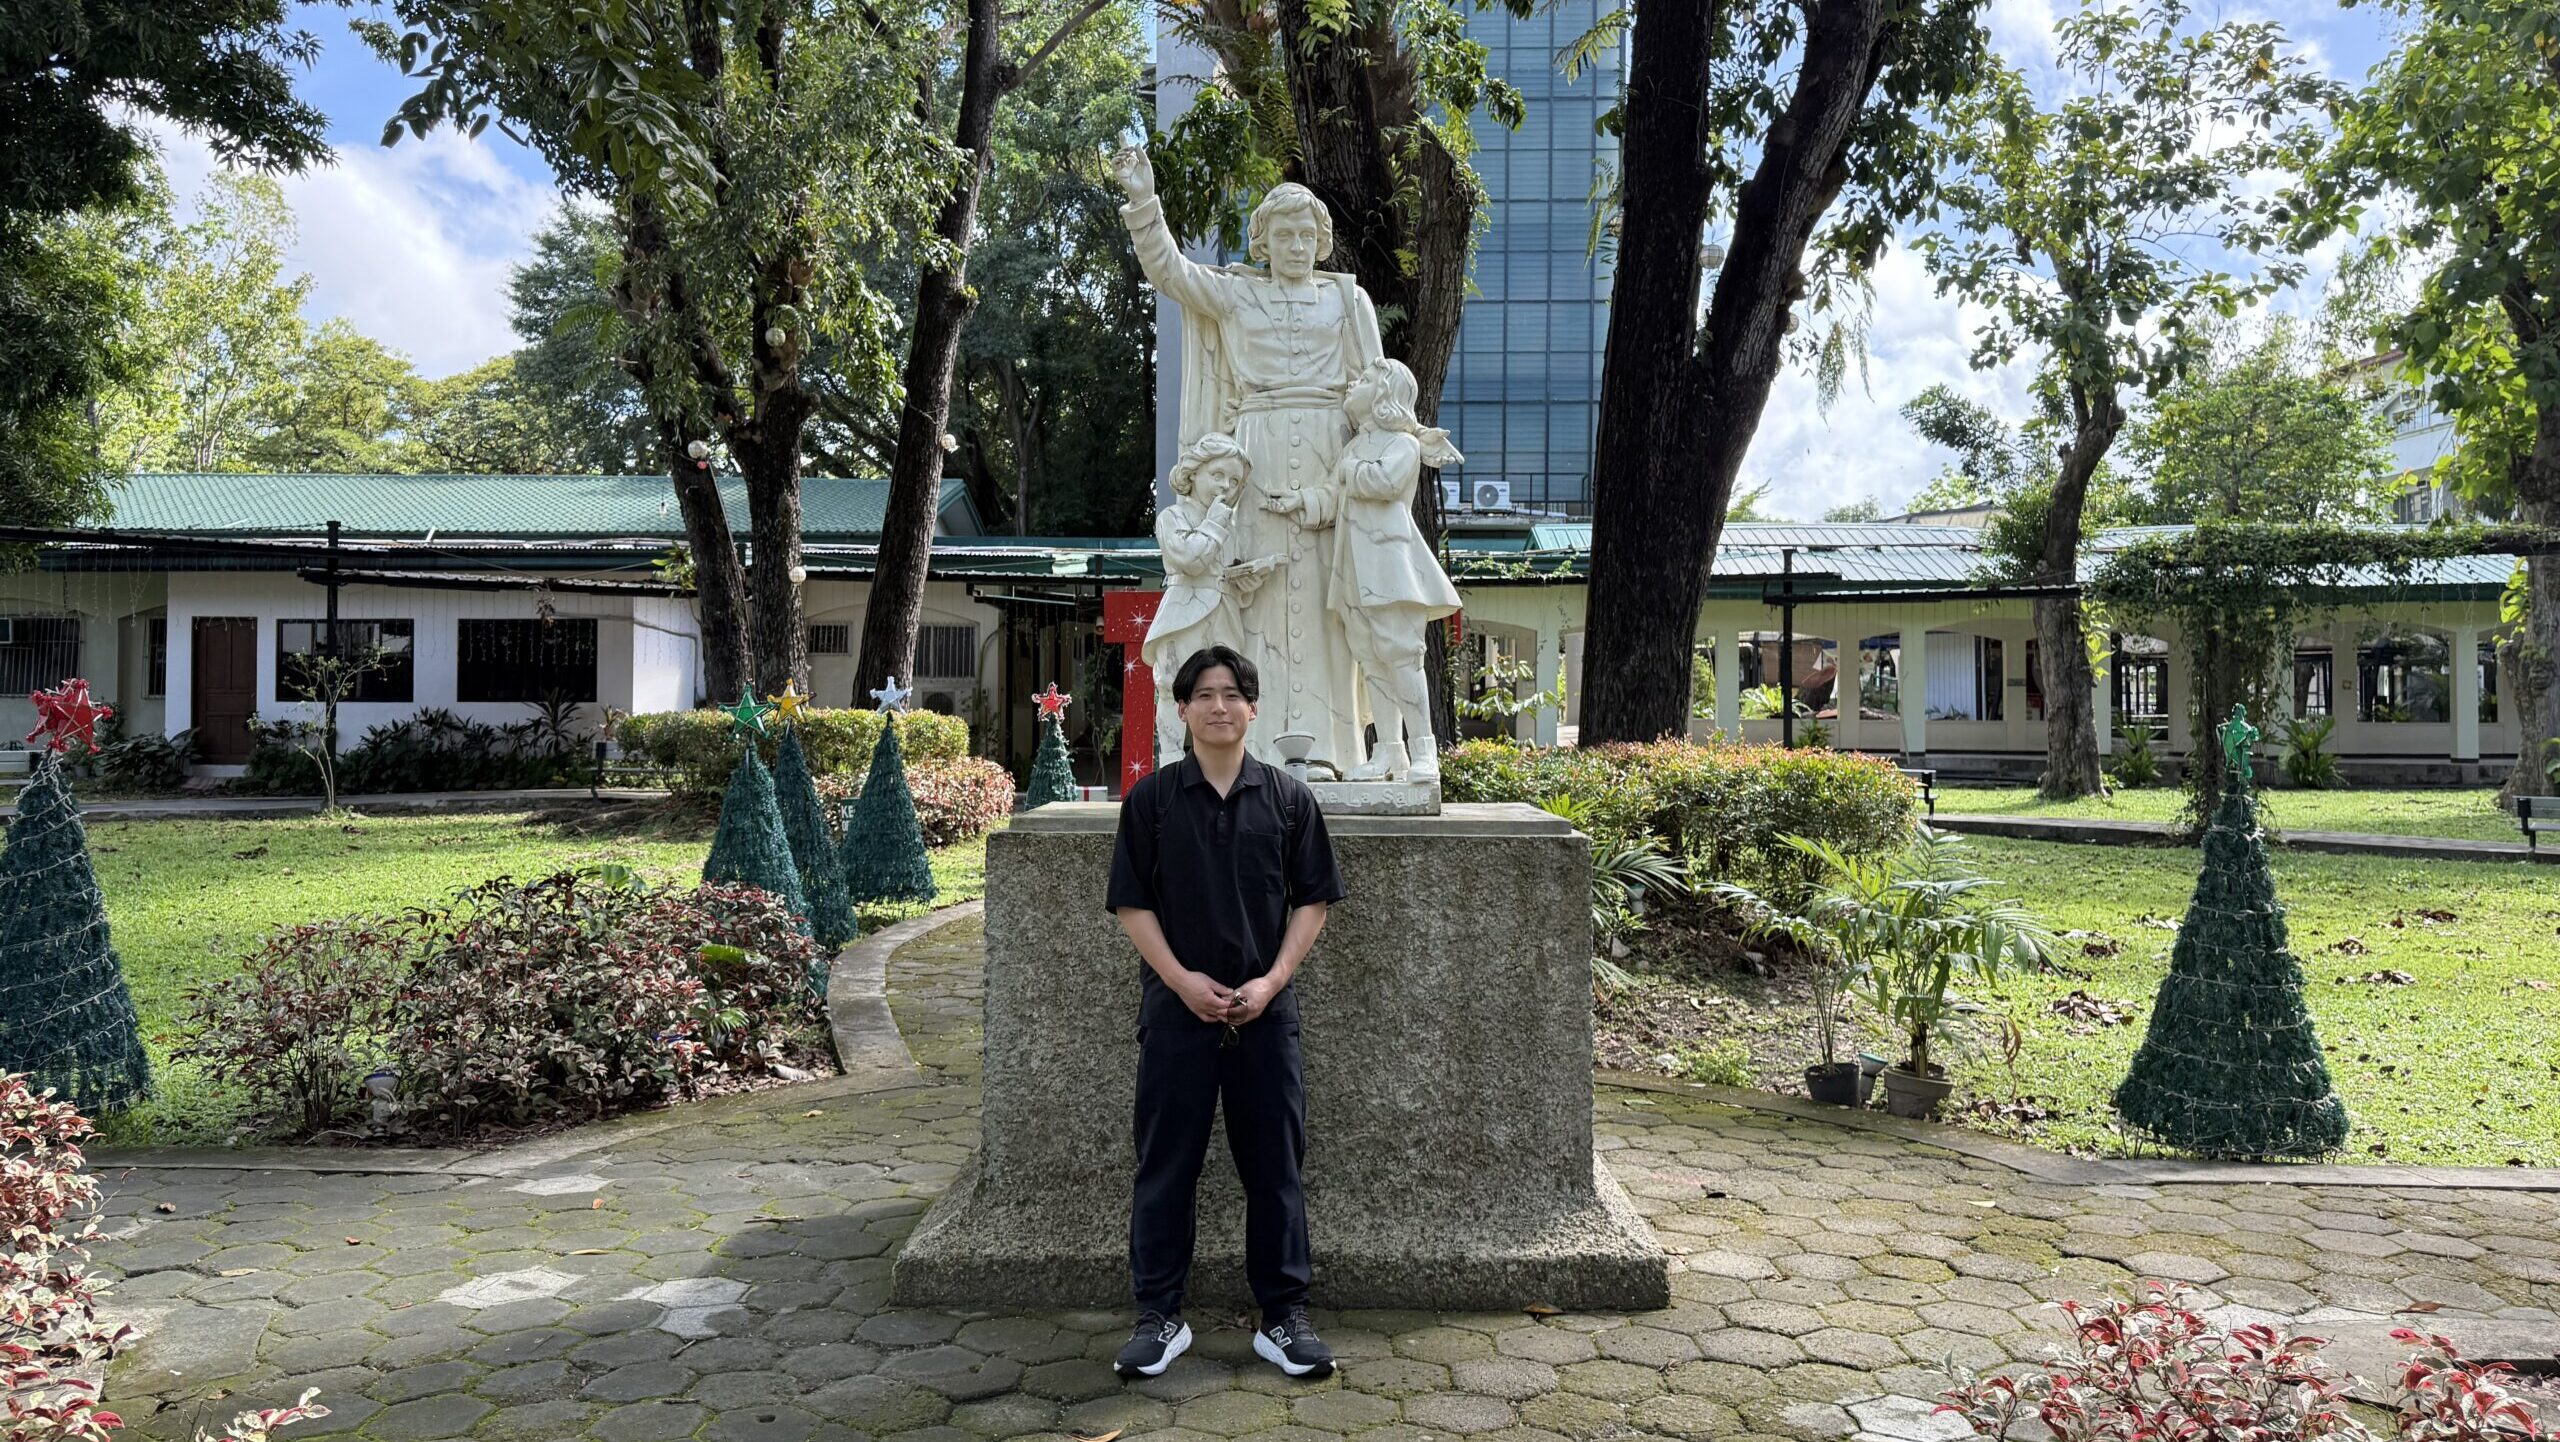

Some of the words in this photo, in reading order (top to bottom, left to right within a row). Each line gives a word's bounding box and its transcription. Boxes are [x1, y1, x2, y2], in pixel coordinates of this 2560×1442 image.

[1314, 788, 1339, 803] De
[841, 805, 855, 818] KE
[1269, 1326, 1292, 1349] N
